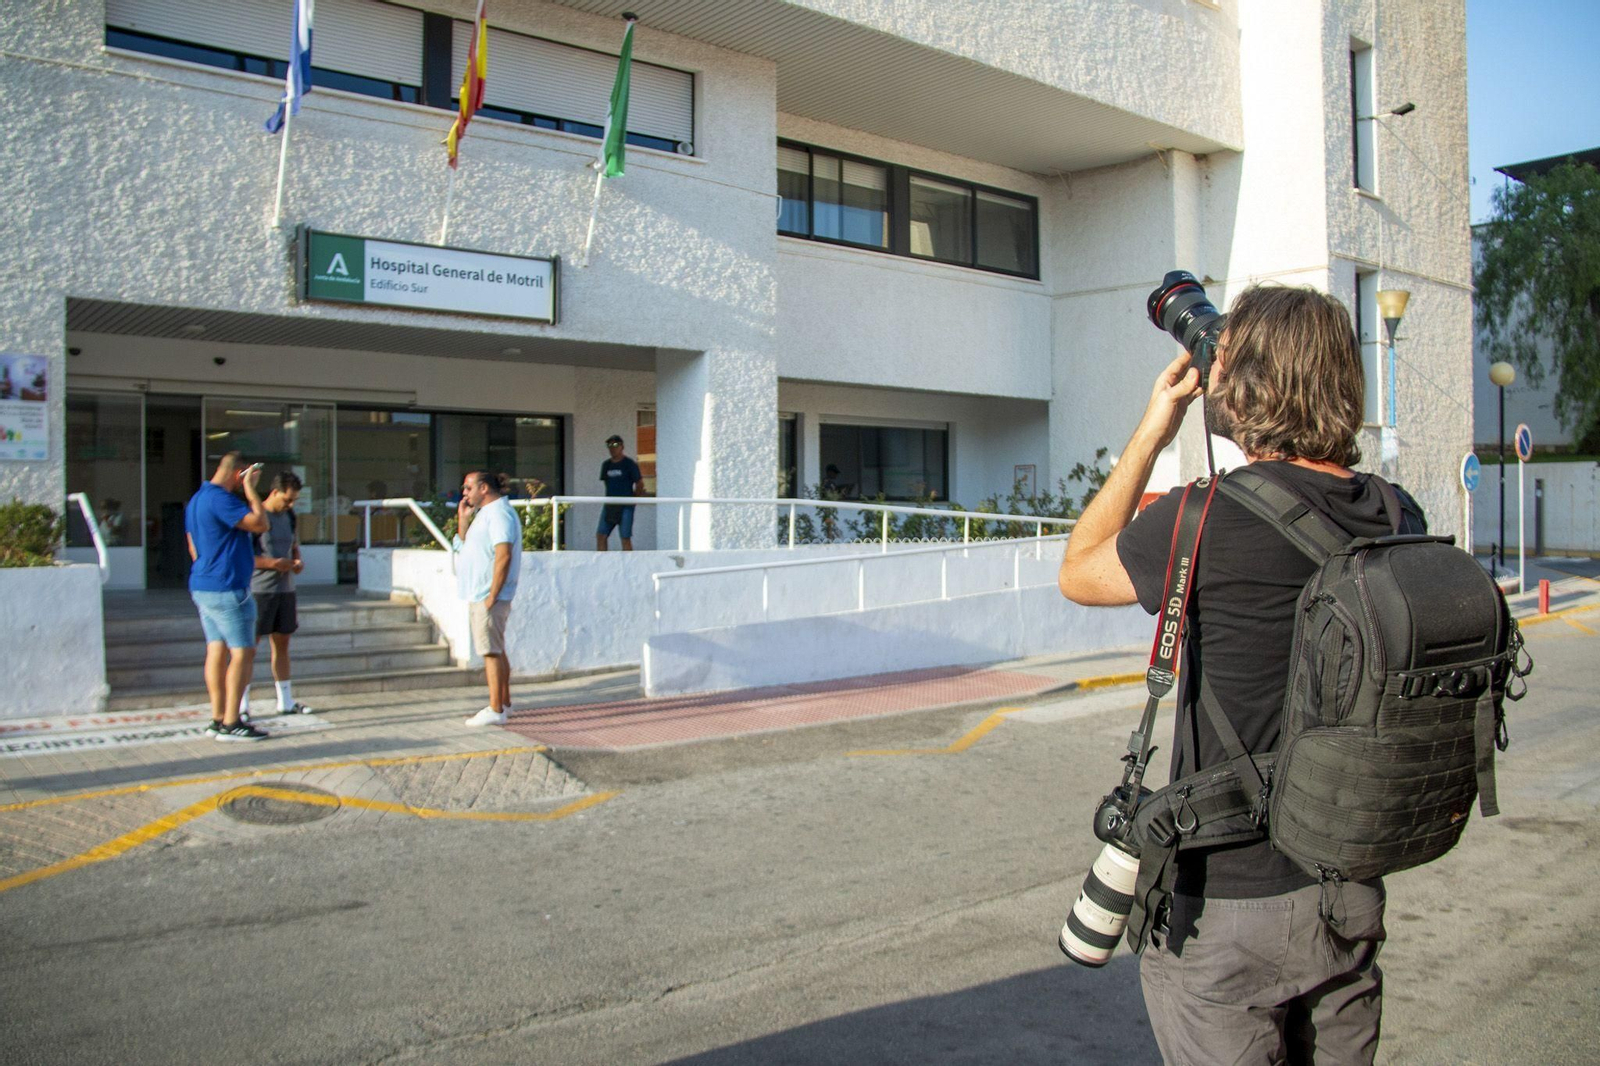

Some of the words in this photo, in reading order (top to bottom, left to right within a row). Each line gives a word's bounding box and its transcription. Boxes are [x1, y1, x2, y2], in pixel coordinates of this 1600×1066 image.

[370, 257, 429, 276] Hospital
[432, 264, 485, 282] General
[487, 270, 503, 284] de
[506, 272, 544, 288] Motril
[370, 279, 409, 292] Edificio
[410, 282, 429, 294] Sur
[1181, 557, 1190, 567] III
[1176, 567, 1188, 594] Mark
[1167, 596, 1183, 617] 5D
[1160, 620, 1178, 660] EOS
